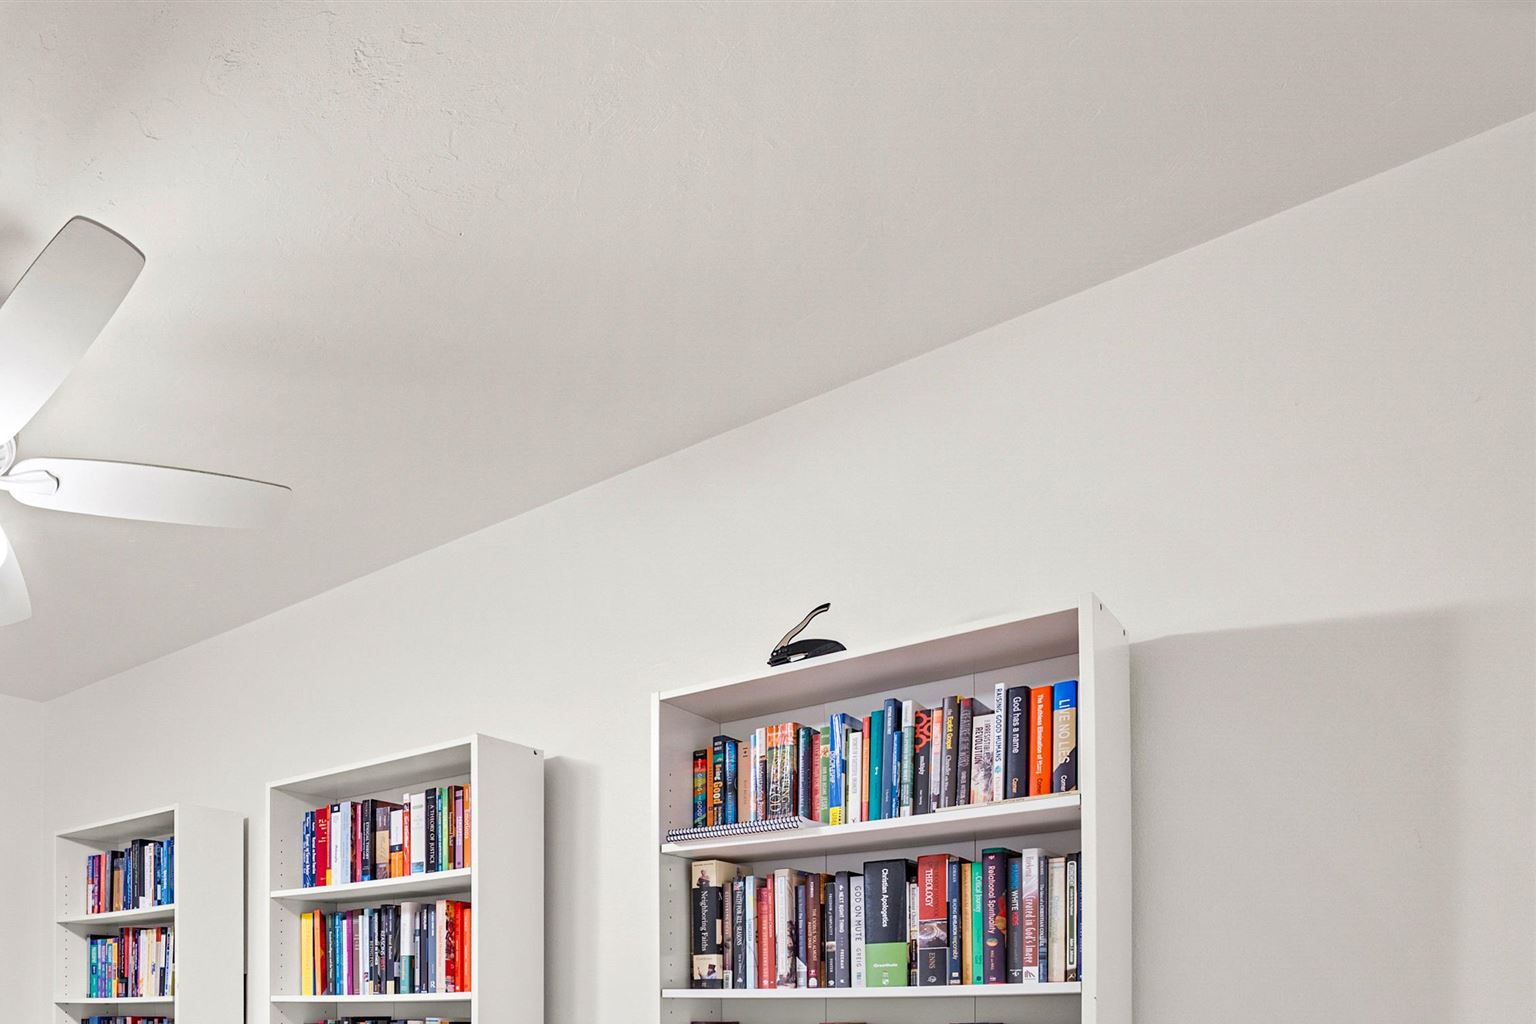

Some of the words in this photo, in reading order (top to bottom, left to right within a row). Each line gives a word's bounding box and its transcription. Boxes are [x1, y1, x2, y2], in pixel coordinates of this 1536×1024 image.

[1012, 697, 1021, 712] God
[1059, 699, 1070, 721] LIVE
[1012, 713, 1021, 726] has
[1059, 724, 1070, 739] NO
[1012, 734, 1020, 753] name
[1059, 742, 1070, 763] LIES
[713, 781, 723, 804] Good
[429, 833, 435, 841] OF
[925, 869, 933, 907] THEOLOGY
[988, 866, 996, 898] Relational
[700, 891, 708, 931] Neighboring
[854, 905, 861, 917] ON
[988, 899, 996, 934] Spirituality
[1024, 895, 1038, 918] Created
[1024, 927, 1038, 944] God's
[1024, 945, 1038, 963] Image
